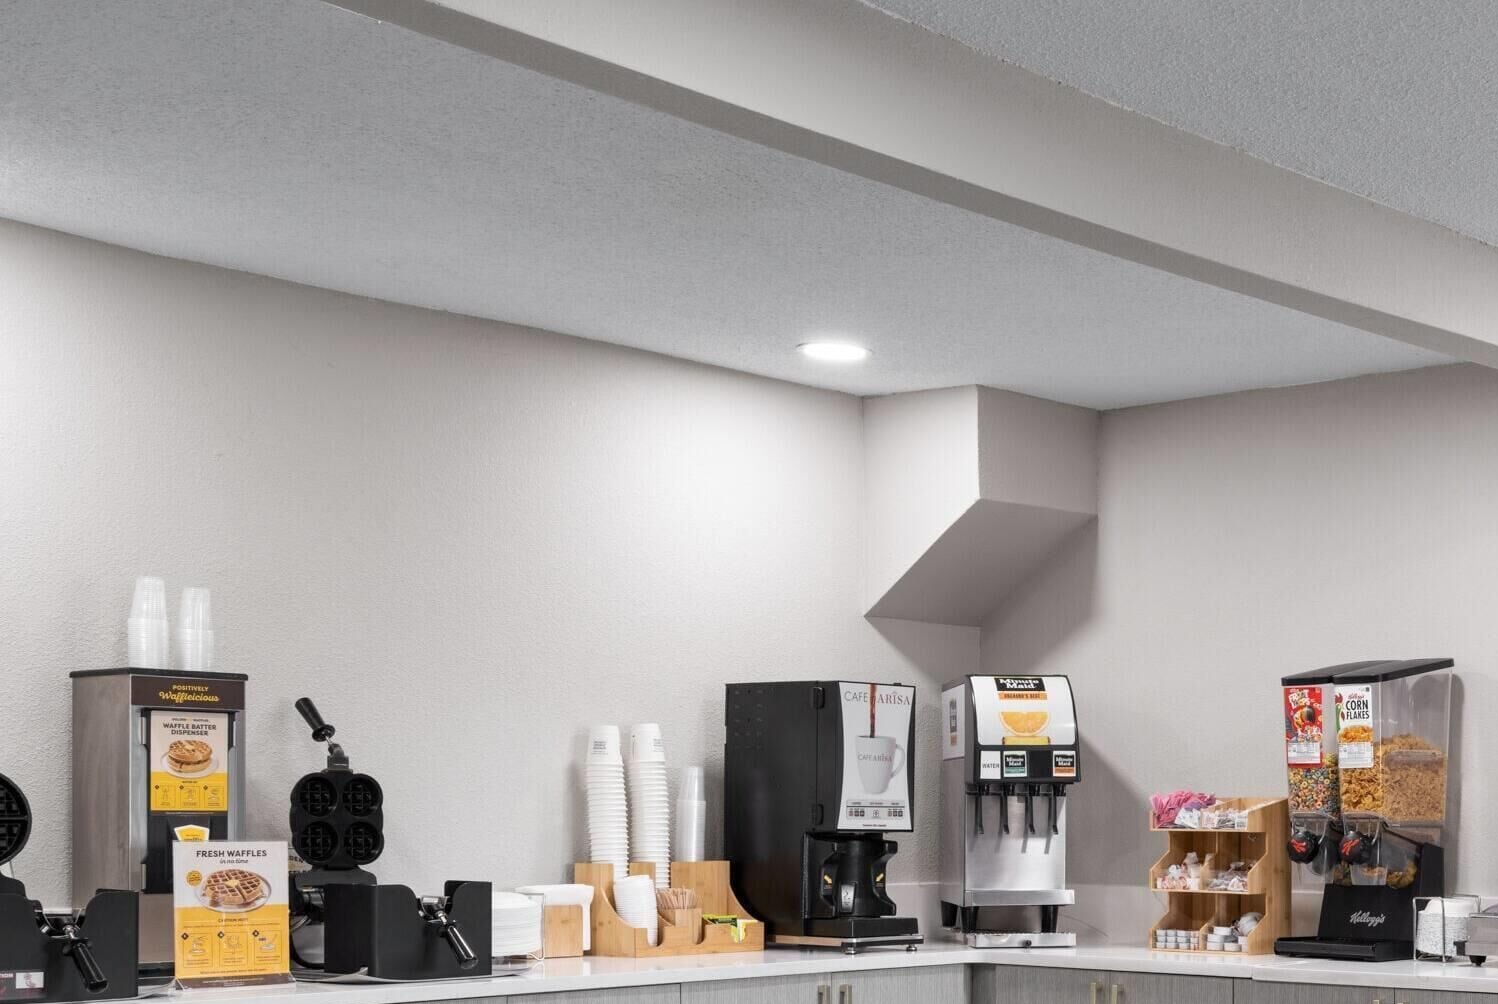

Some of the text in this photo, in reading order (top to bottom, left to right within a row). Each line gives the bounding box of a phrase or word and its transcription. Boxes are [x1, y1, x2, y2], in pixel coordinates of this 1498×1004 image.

[172, 684, 209, 692] POSITIVELY
[1345, 699, 1369, 711] CORN
[1346, 710, 1370, 720] FLAKES
[163, 722, 190, 730] WAFFLE
[171, 729, 208, 737] DISPENSER
[196, 849, 268, 858] FRESH WAFFLES
